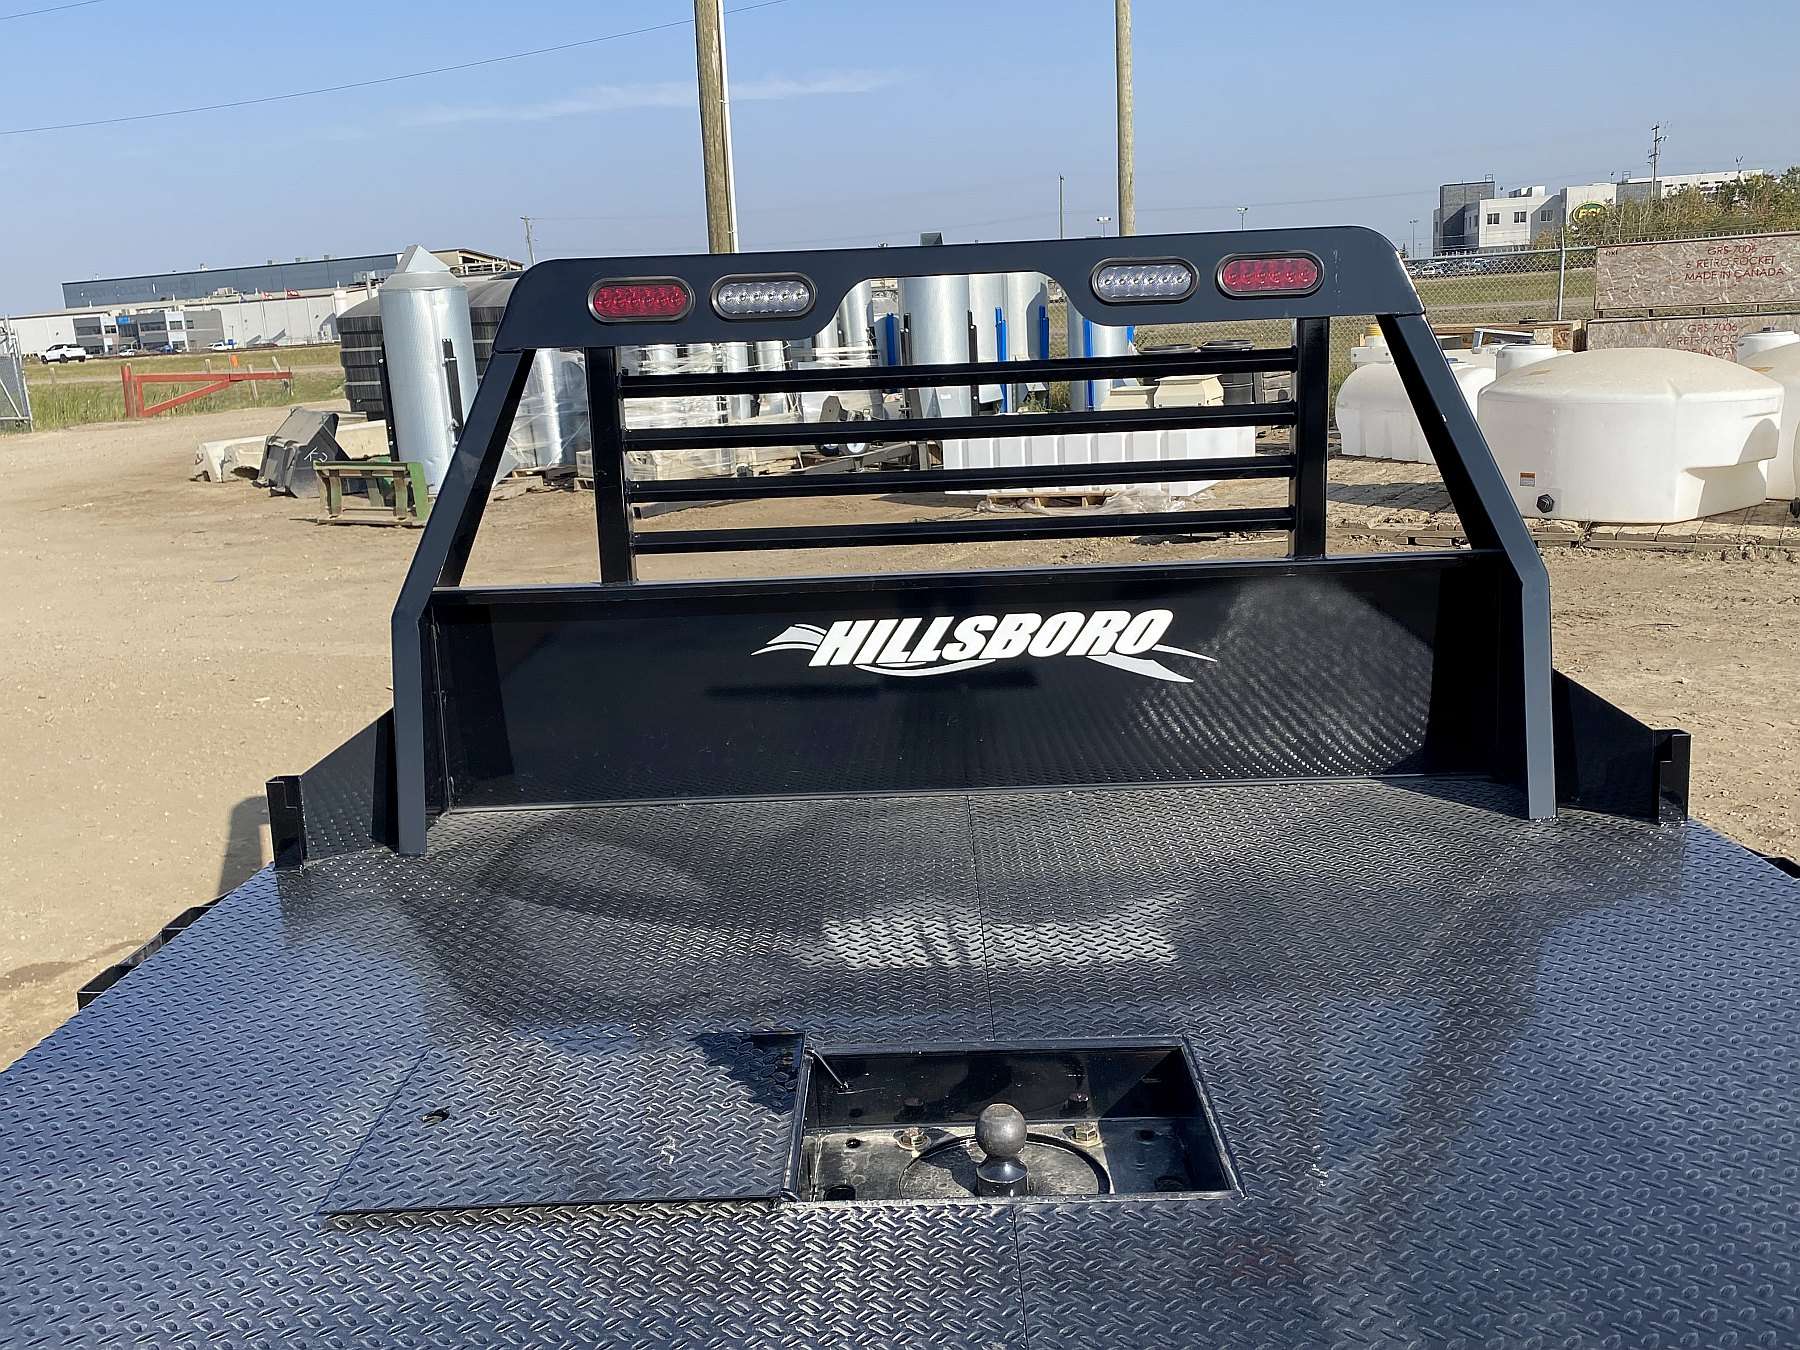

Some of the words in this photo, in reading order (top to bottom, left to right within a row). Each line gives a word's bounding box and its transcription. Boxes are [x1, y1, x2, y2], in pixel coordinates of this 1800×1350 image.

[1696, 257, 1730, 269] RETRO
[1733, 255, 1776, 266] ROCKET
[1684, 270, 1717, 280] MADE
[1720, 270, 1731, 279] IN
[1734, 267, 1784, 278] CANADA
[1713, 334, 1738, 344] ROC
[808, 608, 1174, 667] HILLSBORO
